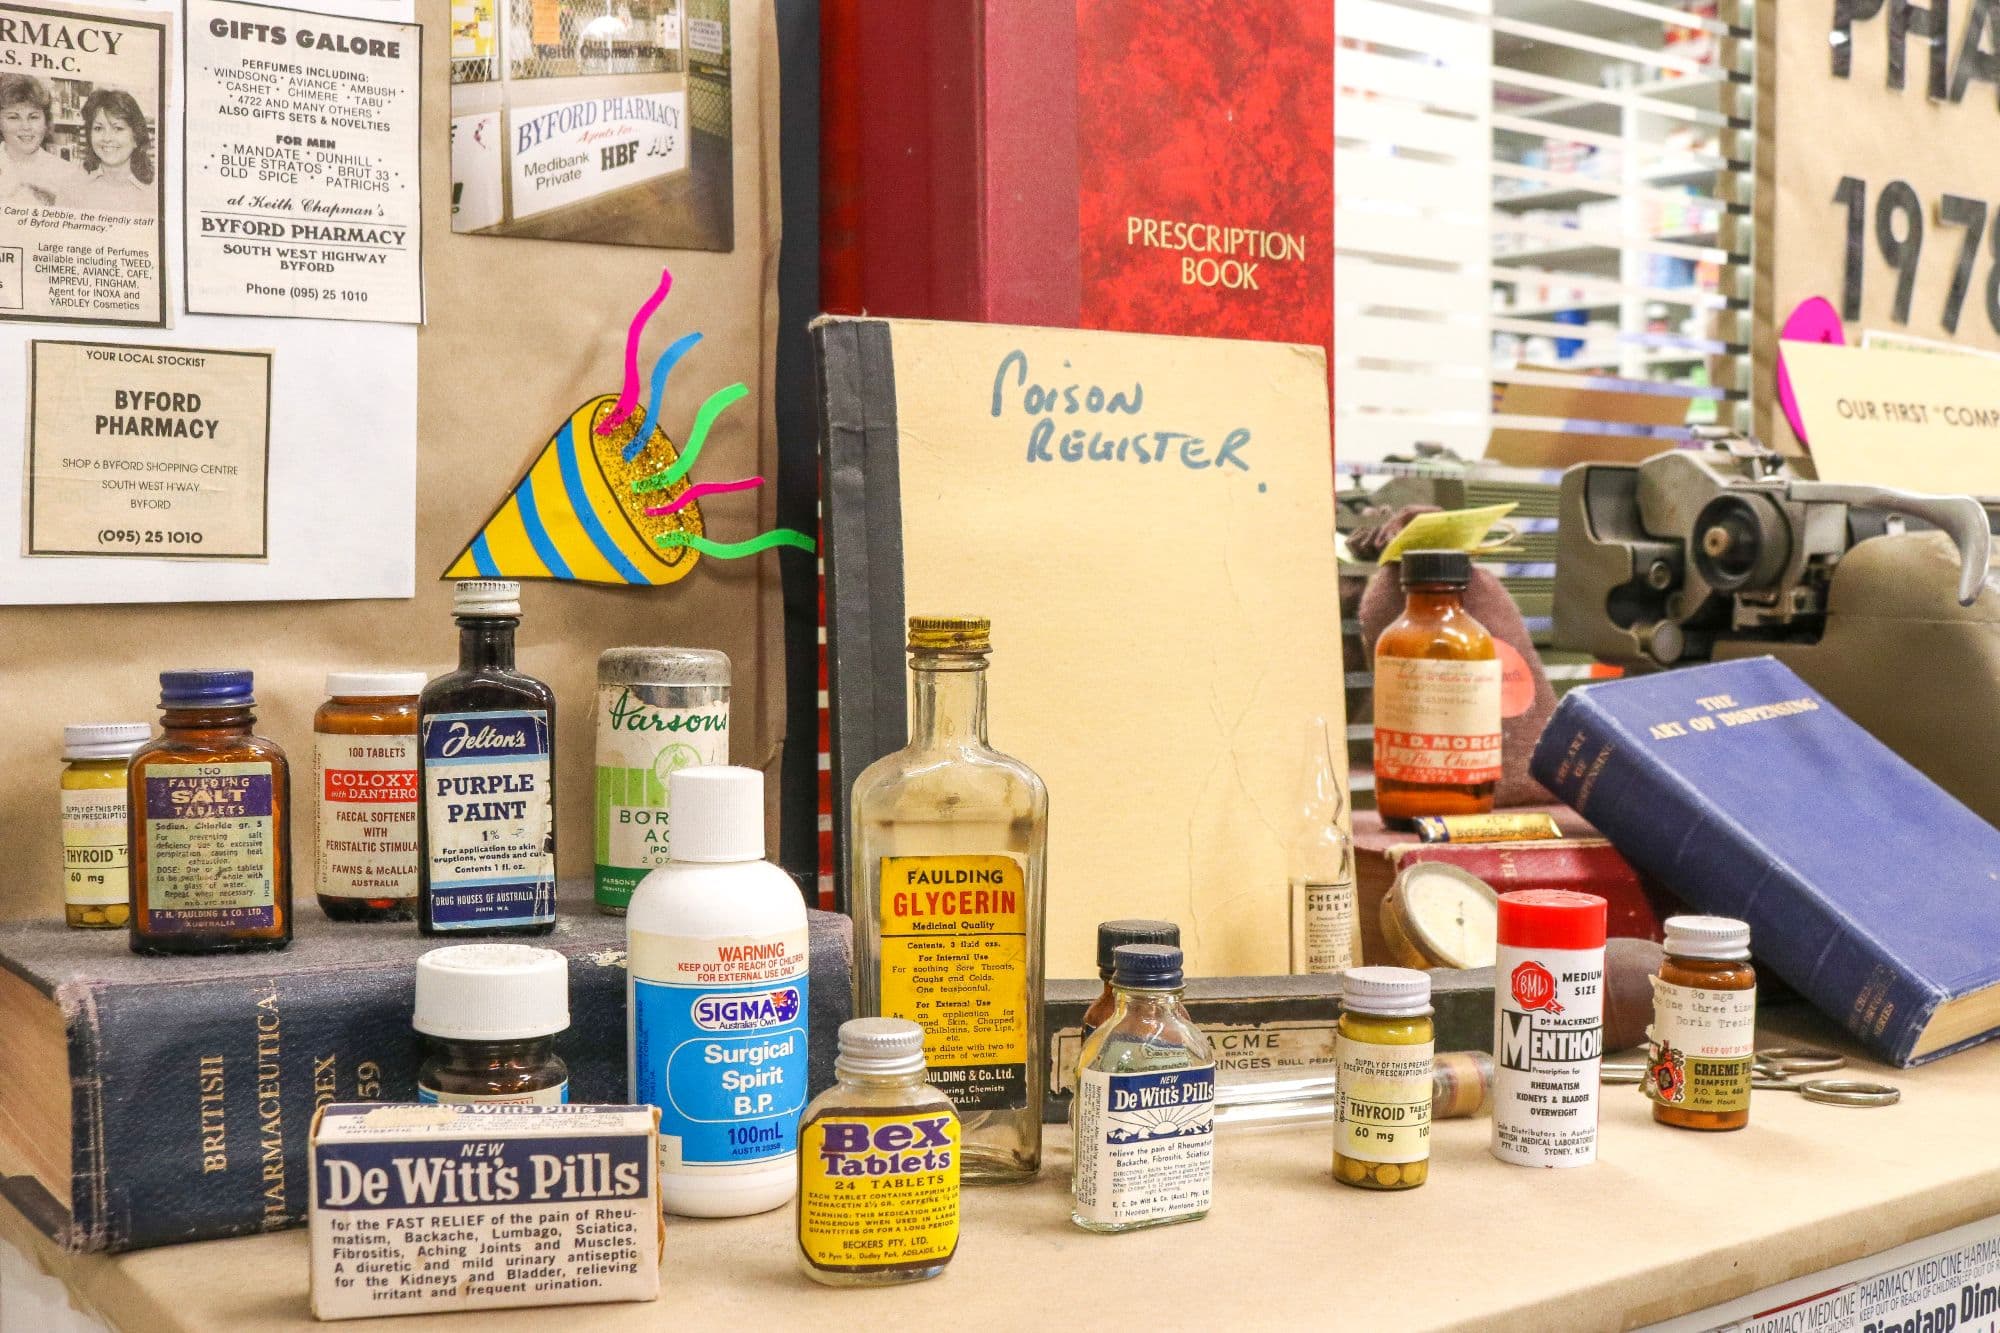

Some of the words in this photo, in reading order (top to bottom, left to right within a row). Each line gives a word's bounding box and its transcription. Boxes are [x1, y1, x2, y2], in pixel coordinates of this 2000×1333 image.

[210, 18, 286, 45] GIFTS
[296, 29, 400, 59] GALORE
[31, 52, 80, 72] Ph.C.
[242, 59, 302, 74] PERFUMES
[306, 64, 368, 82] INCLUDING:
[517, 100, 597, 156] BYFORD
[603, 97, 680, 130] PHARMACY
[276, 135, 302, 146] FOR
[307, 138, 336, 149] MEN
[524, 151, 590, 177] Medibank
[601, 141, 639, 172] HBF
[220, 167, 248, 179] OLD
[259, 170, 298, 184] SPICE
[327, 177, 389, 192] PATRICHS
[536, 169, 582, 191] Private
[201, 217, 285, 238] BYFORD
[292, 225, 406, 245] PHARMACY
[1127, 216, 1306, 262] PRESCRIPTION
[38, 243, 63, 253] Large
[67, 246, 92, 255] range
[96, 246, 104, 254] of
[108, 247, 149, 257] Perfumes
[224, 244, 271, 256] SOUTH
[276, 248, 317, 260] WEST
[322, 251, 386, 264] HIGHWAY
[1831, 175, 2000, 335] 197
[280, 261, 334, 273] BYFORD
[1181, 256, 1259, 291] BOOK
[247, 283, 285, 296] Phone
[290, 286, 318, 300] (095)
[323, 289, 336, 299] 25
[341, 291, 368, 302] 1010
[50, 298, 90, 308] YARDLEY
[94, 300, 140, 309] Cosmetics
[87, 351, 115, 362] YOUR
[119, 353, 154, 364] LOCAL
[158, 356, 206, 368] STOCKIST
[991, 348, 1143, 418] Poison
[115, 390, 201, 412] BYFORD
[1837, 398, 1880, 421] OUR
[1883, 402, 1928, 424] FIRST
[95, 415, 219, 439] PHARMACY
[62, 459, 91, 470] SHOP
[94, 459, 100, 470] 6
[103, 460, 143, 471] BYFORD
[147, 462, 198, 473] SHOPPING
[200, 464, 238, 475] CENTRE
[97, 530, 140, 545] (095)
[145, 531, 163, 543] 25
[168, 531, 202, 543] 1010
[1649, 722, 1688, 741] ART
[1689, 716, 1719, 732] OF
[349, 748, 363, 758] 100
[367, 748, 406, 758] TABLETS
[169, 778, 250, 788] FAULDING
[331, 774, 417, 787] COLOXY
[437, 774, 534, 796] PURPLE
[171, 790, 247, 804] SALT
[175, 805, 246, 816] TABLETS
[337, 811, 368, 822] FAECAL
[371, 811, 415, 822] SOFTENER
[447, 801, 527, 823] PAINT
[364, 827, 387, 837] WITH
[326, 841, 377, 852] PERISTALTIC
[66, 849, 113, 864] THYROID
[71, 872, 81, 883] 60
[88, 874, 104, 884] mg
[351, 879, 399, 887] AUSTRALIA
[907, 870, 1003, 885] FAULDING
[435, 895, 454, 906] DRUG
[457, 894, 483, 905] HOUSES
[486, 894, 494, 903] OF
[496, 892, 533, 902] AUSTRALIA
[894, 890, 1016, 917] GLYCERIN
[912, 921, 957, 931] Medicinal
[961, 921, 995, 930] Quality
[719, 942, 785, 962] WARNING
[698, 972, 715, 982] FOR
[719, 972, 762, 982] EXTERNAL
[765, 969, 779, 979] USE
[780, 967, 795, 977] ONLY
[1575, 985, 1596, 996] SIZE
[699, 999, 775, 1022] SIGMA
[704, 1036, 794, 1065] Surgical
[722, 1066, 784, 1092] Spirit
[1160, 1075, 1179, 1084] NEW
[1695, 1064, 1739, 1077] GRAEME
[1531, 1081, 1580, 1091] RHEUMATISM
[1695, 1078, 1737, 1086] DEMPSTER
[734, 1094, 774, 1116] B.P.
[1114, 1089, 1138, 1110] De
[1138, 1086, 1179, 1108] Witt's
[1183, 1082, 1214, 1103] Pills
[1516, 1092, 1547, 1102] KIDNEYS
[1552, 1095, 1558, 1103] &
[1562, 1093, 1590, 1103] BLADDER
[201, 1055, 228, 1174] BRITISH
[1350, 1102, 1405, 1121] THYROID
[1531, 1107, 1577, 1117] OVERWEIGHT
[728, 1121, 784, 1145] 100mL
[820, 1117, 951, 1153] Bex
[1355, 1127, 1369, 1137] 60
[1376, 1132, 1394, 1142] mg
[460, 1142, 505, 1157] NEW
[820, 1150, 950, 1176] Tablets
[324, 1159, 389, 1206] De
[392, 1155, 519, 1204] Witt's
[529, 1152, 640, 1199] Pills
[835, 1181, 855, 1190] 24
[872, 1175, 945, 1189] TABLETS
[331, 1218, 351, 1231] for
[356, 1218, 380, 1230] the
[386, 1217, 424, 1229] FAST
[431, 1214, 486, 1227] RELIEF
[491, 1213, 505, 1225] of
[510, 1212, 532, 1225] the
[539, 1212, 569, 1227] pain
[575, 1209, 589, 1221] of
[595, 1208, 637, 1220] Rheu-
[333, 1234, 391, 1248] matism,
[404, 1230, 479, 1244] Backache,
[492, 1225, 563, 1241] Lumbago,
[576, 1221, 638, 1236] Sciatica,
[843, 1238, 884, 1249] BECKERS
[911, 1237, 929, 1245] LTD.
[1860, 1268, 1914, 1307] PHARMACY
[1918, 1252, 1962, 1287] MEDICINE
[1859, 1308, 1874, 1321] KEEP
[1875, 1302, 1890, 1315] OUT
[1890, 1298, 1900, 1309] OF
[1901, 1291, 1922, 1307] REACH
[1922, 1288, 1931, 1298] OF
[1932, 1276, 1962, 1295] CHILDREN
